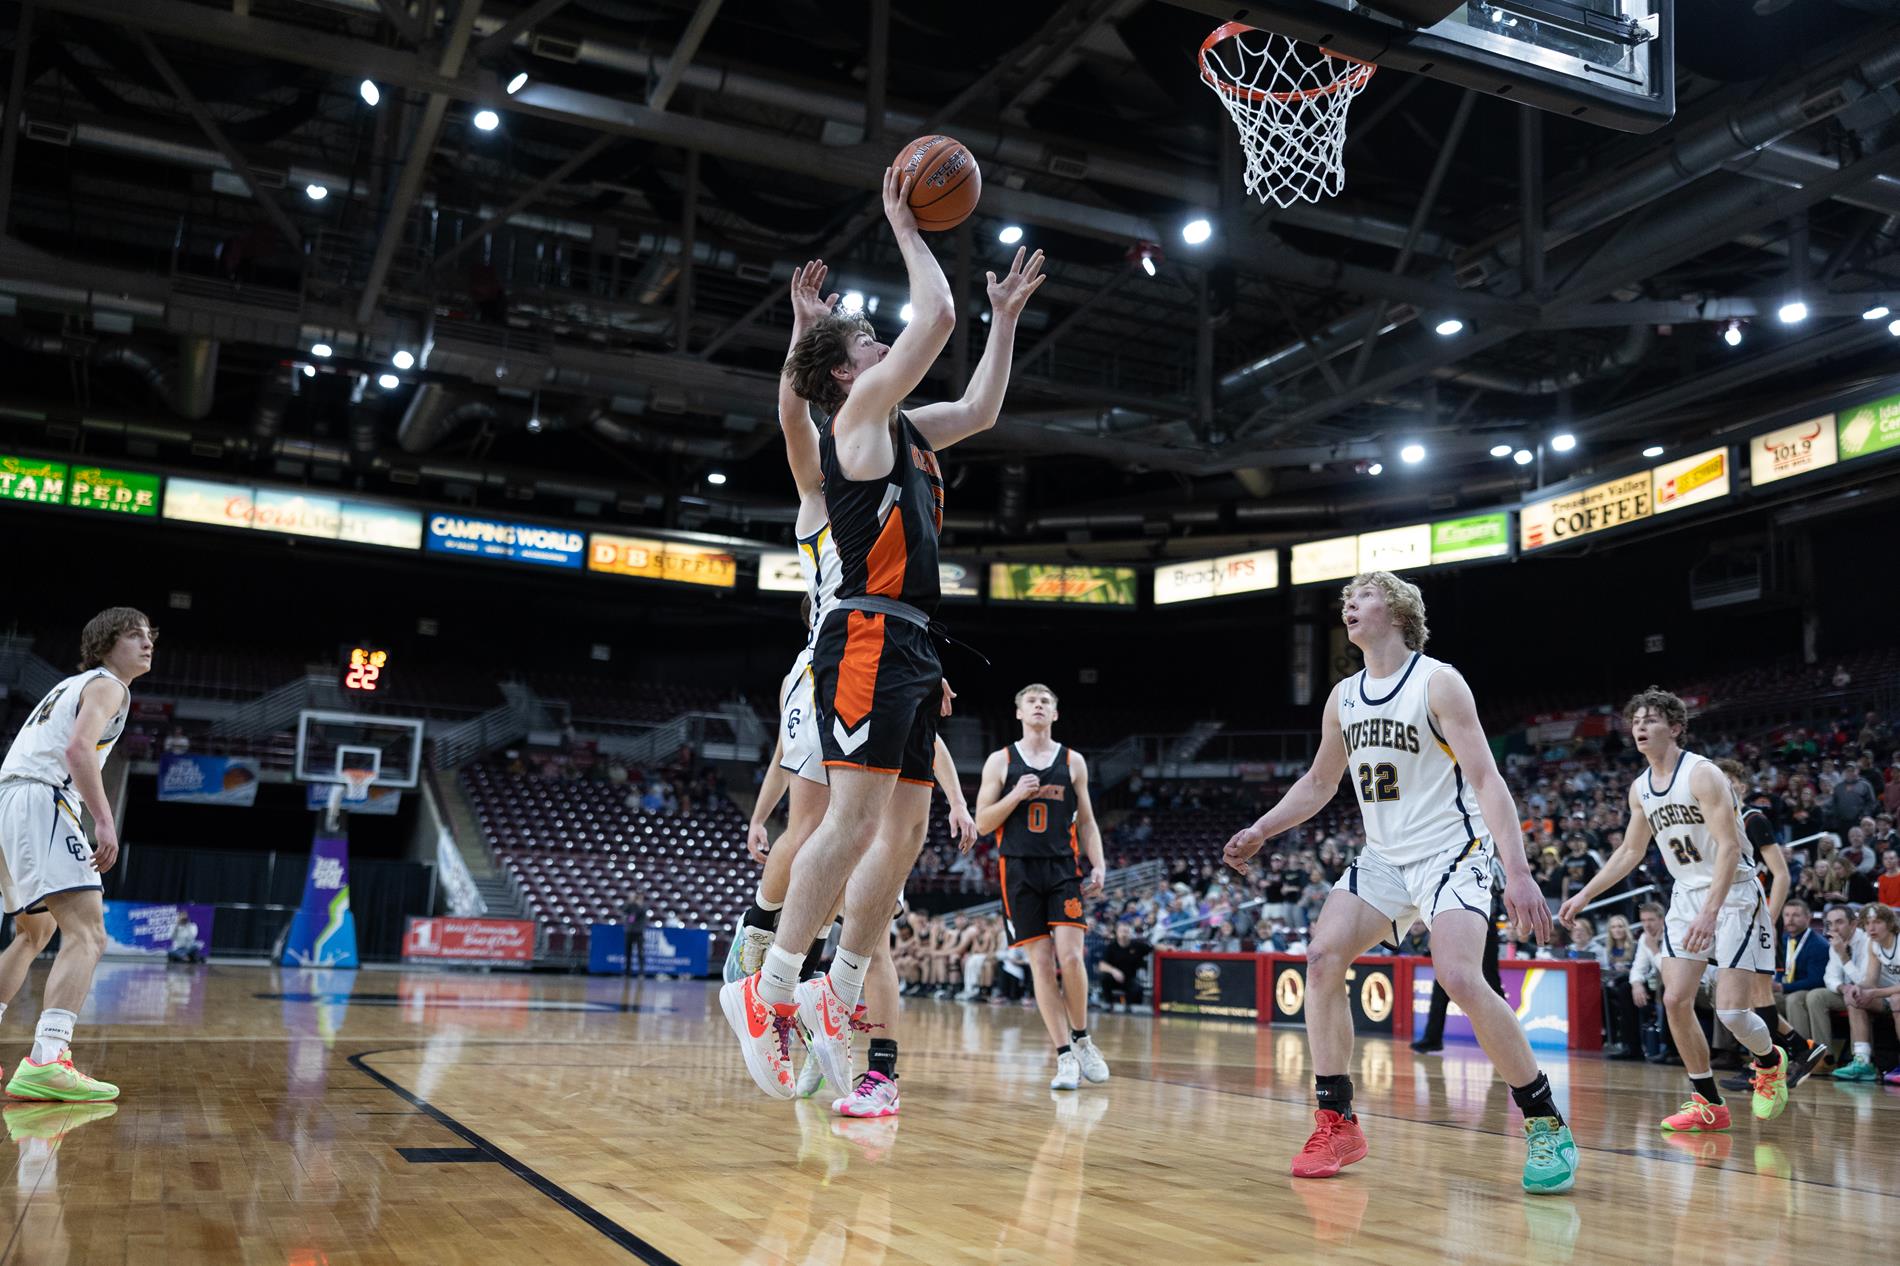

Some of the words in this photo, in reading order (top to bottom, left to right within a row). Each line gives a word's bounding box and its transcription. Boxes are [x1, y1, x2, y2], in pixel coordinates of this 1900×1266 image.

[1773, 440, 1812, 461] 101.9
[1608, 479, 1648, 498] Valley
[1553, 493, 1649, 537] COFFEE
[431, 516, 516, 545] CAMPING
[516, 527, 583, 553] WORLD
[1174, 566, 1226, 587] Brady
[346, 663, 379, 690] 22
[1358, 762, 1400, 803] 22
[1028, 802, 1047, 833] 0
[1669, 835, 1703, 866] 24
